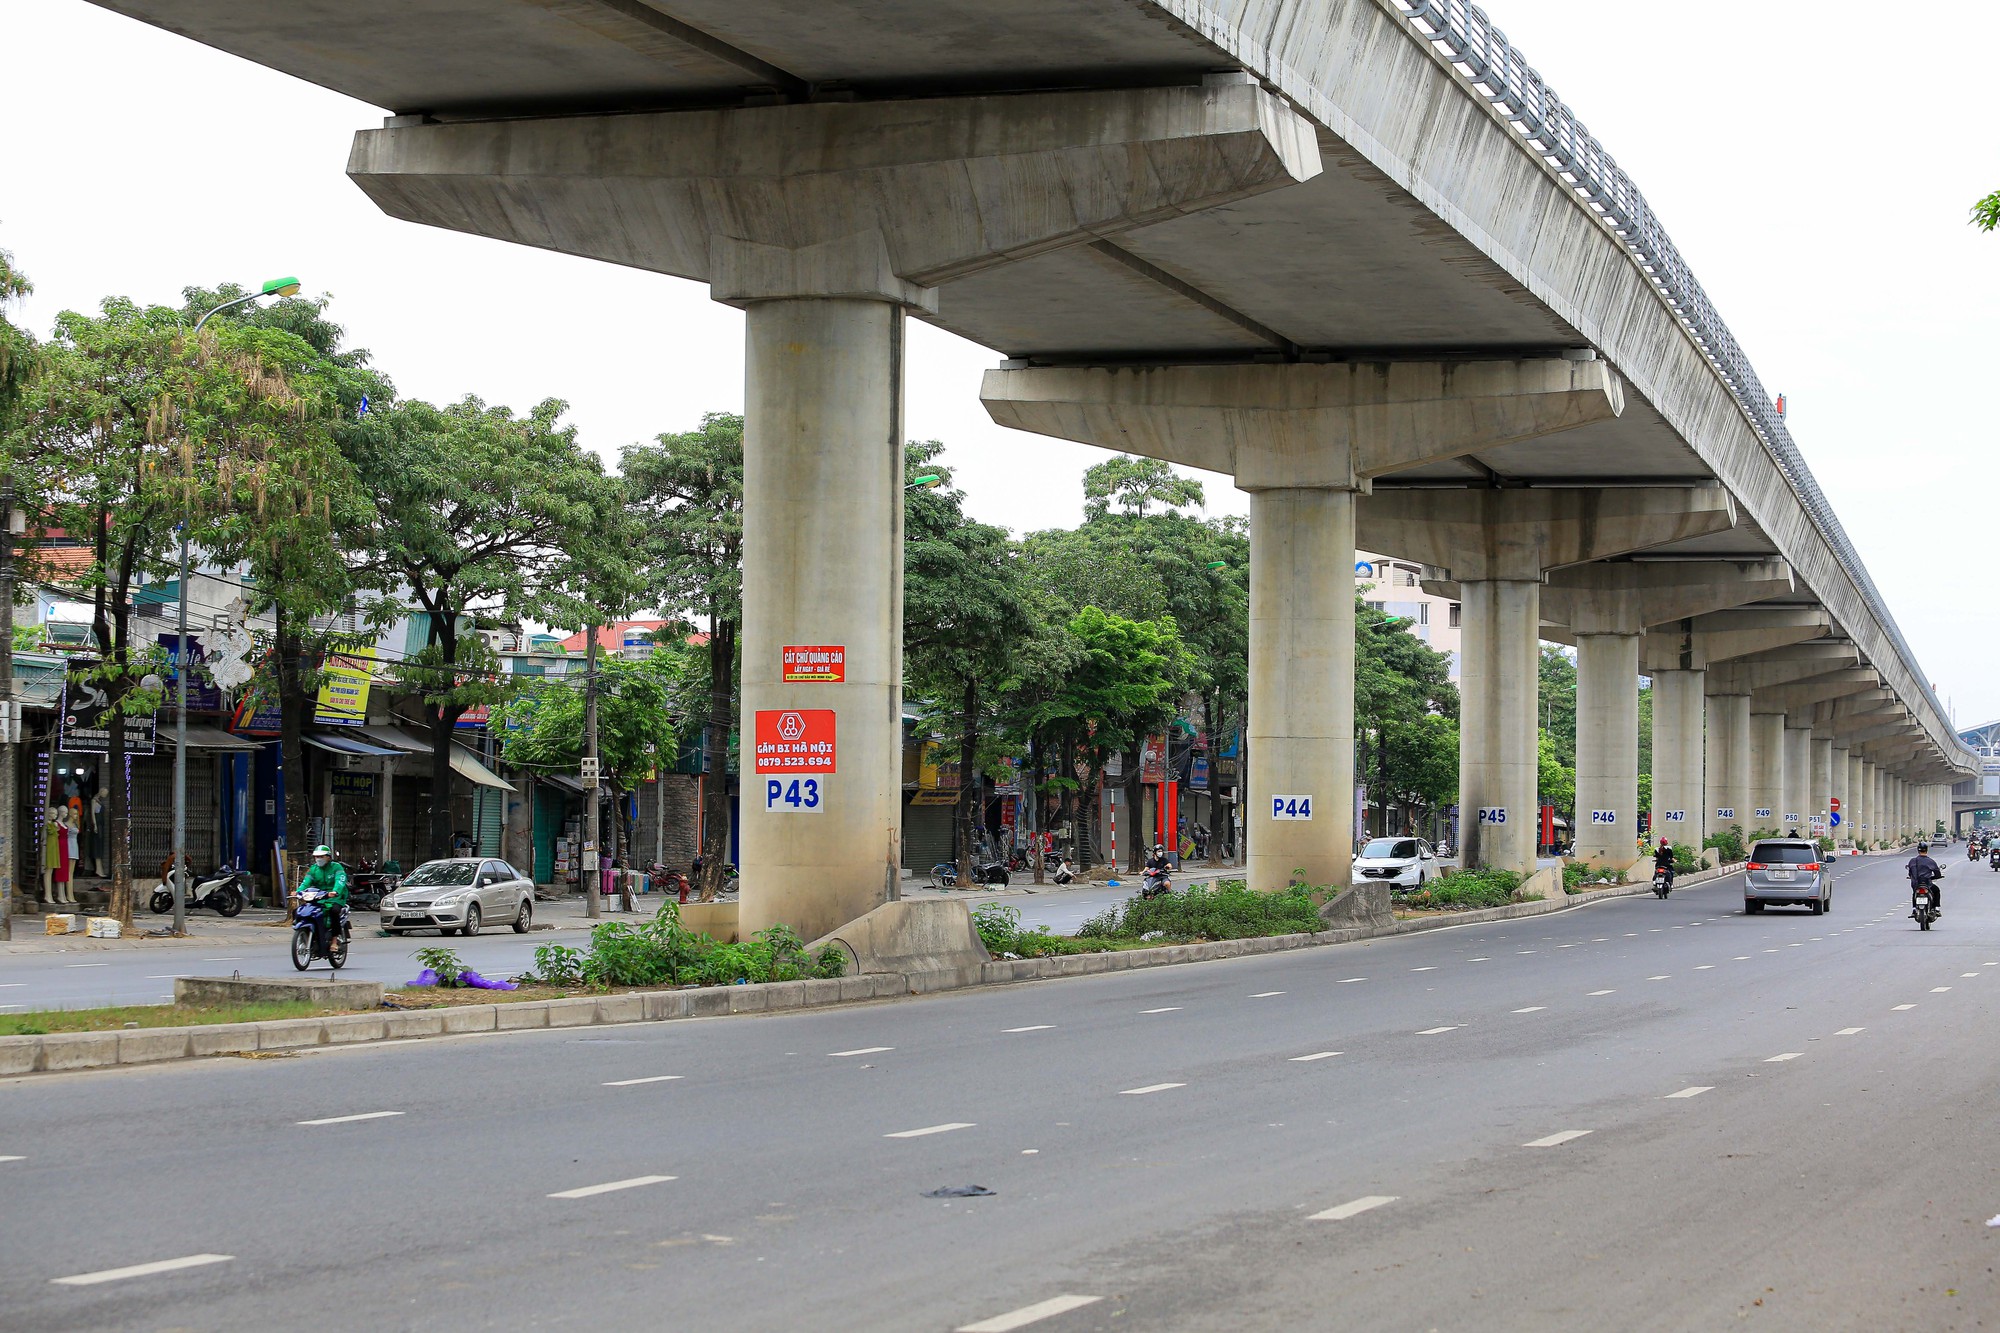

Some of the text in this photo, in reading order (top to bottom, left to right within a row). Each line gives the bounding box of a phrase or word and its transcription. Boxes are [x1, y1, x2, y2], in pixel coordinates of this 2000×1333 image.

[785, 648, 843, 664] CẮT CHỮ QUẢNG CÁO
[778, 744, 790, 753] BI
[810, 741, 832, 755] NỘI
[758, 757, 832, 766] 0879.523.694
[768, 779, 819, 808] P43
[1274, 799, 1310, 817] P44
[1718, 810, 1733, 818] P48
[1479, 809, 1506, 823] P45
[1593, 812, 1614, 822] P46
[1666, 812, 1684, 820] P47
